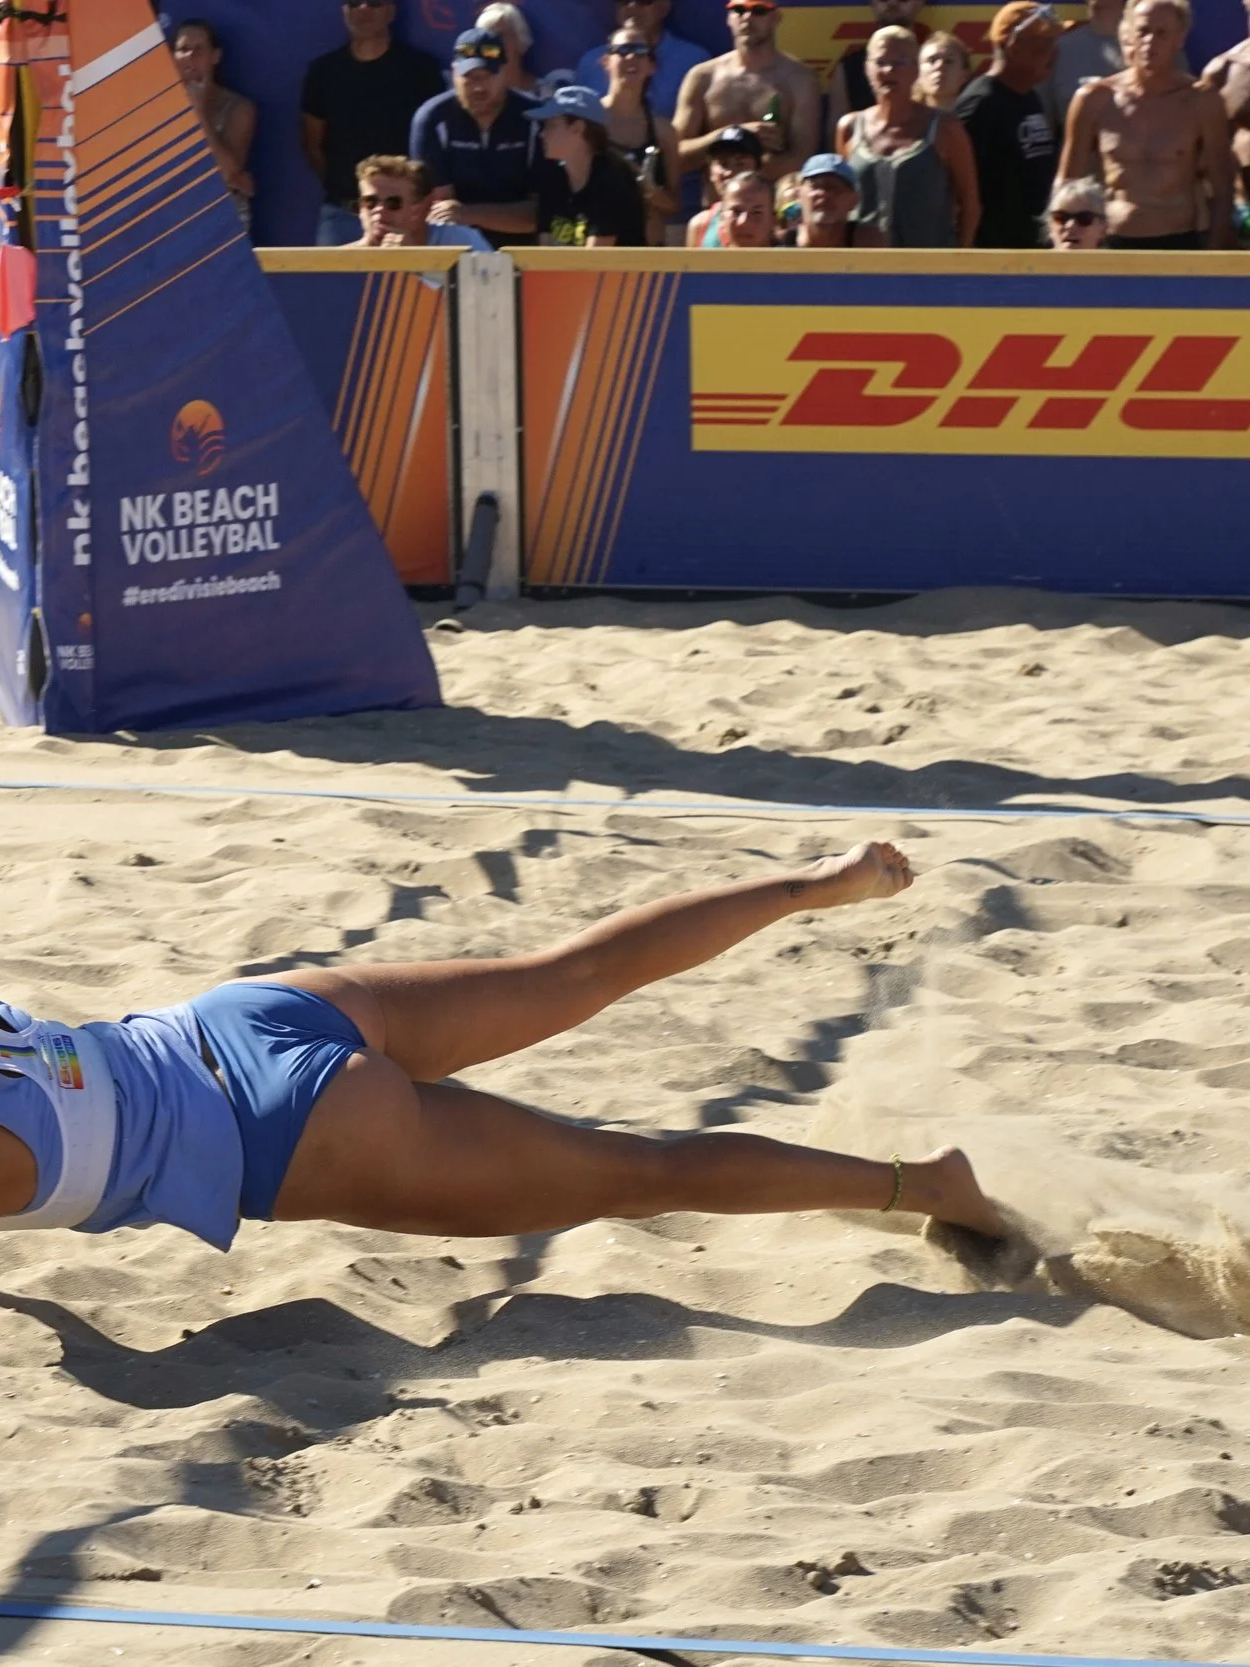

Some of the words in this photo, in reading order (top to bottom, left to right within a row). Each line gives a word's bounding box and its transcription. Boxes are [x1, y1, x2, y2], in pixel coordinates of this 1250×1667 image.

[779, 332, 1250, 431] DHL
[120, 493, 167, 532] NK
[172, 482, 279, 526] BEACH
[121, 519, 281, 566] VOLLEYBAL
